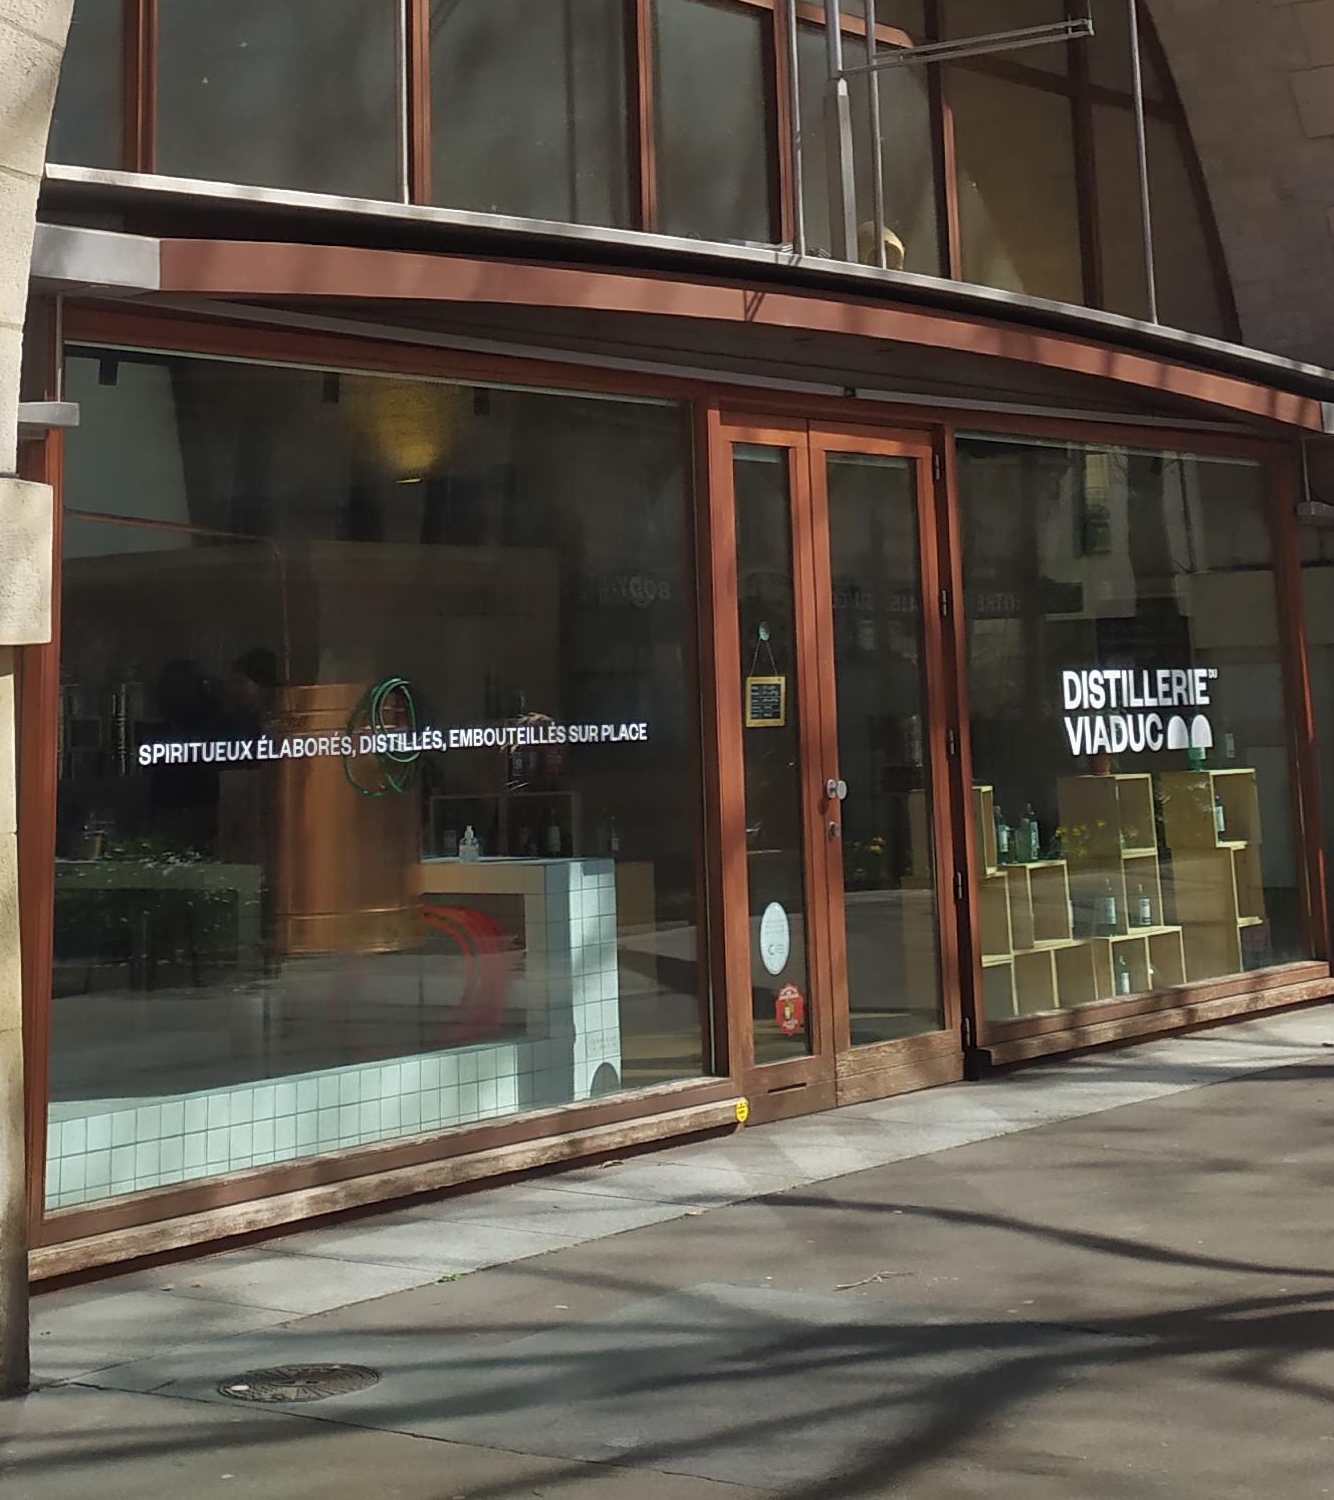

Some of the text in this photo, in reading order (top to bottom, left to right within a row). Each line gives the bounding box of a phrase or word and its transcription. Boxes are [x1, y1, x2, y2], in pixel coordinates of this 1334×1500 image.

[1062, 667, 1210, 710] DISTILLERIE
[138, 721, 648, 766] SPIRITUEUX ÉLABORÉS, DISTILLÉS, EMBOUTEILLÉS SUR PLACE
[1064, 712, 1164, 756] VIADUC
